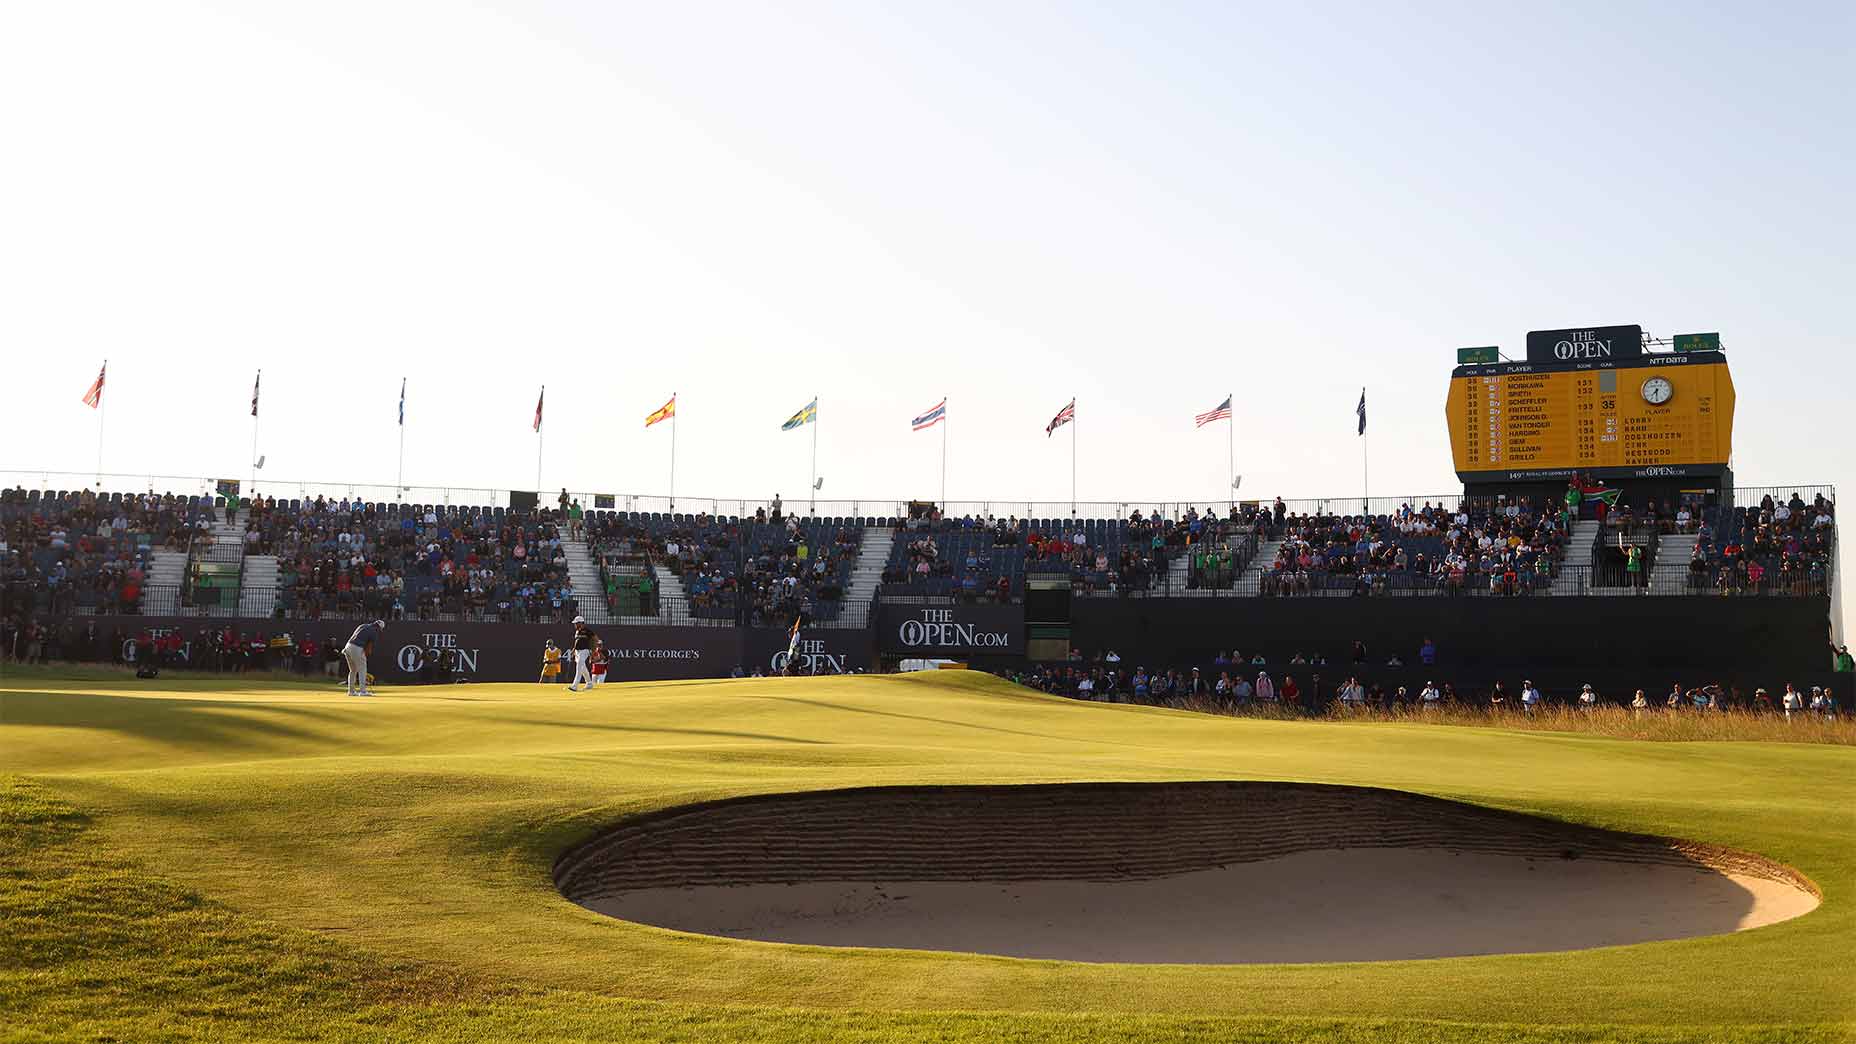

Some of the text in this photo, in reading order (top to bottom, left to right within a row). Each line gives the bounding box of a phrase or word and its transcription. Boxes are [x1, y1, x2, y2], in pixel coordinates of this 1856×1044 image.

[1570, 332, 1596, 342] THE
[1554, 340, 1612, 360] OPEN
[1602, 400, 1614, 410] 35
[921, 609, 952, 622] THE
[900, 620, 1008, 646] OPEN.COM
[422, 634, 456, 648] THE
[634, 649, 646, 658] ST
[648, 649, 700, 658] GEORGE'S
